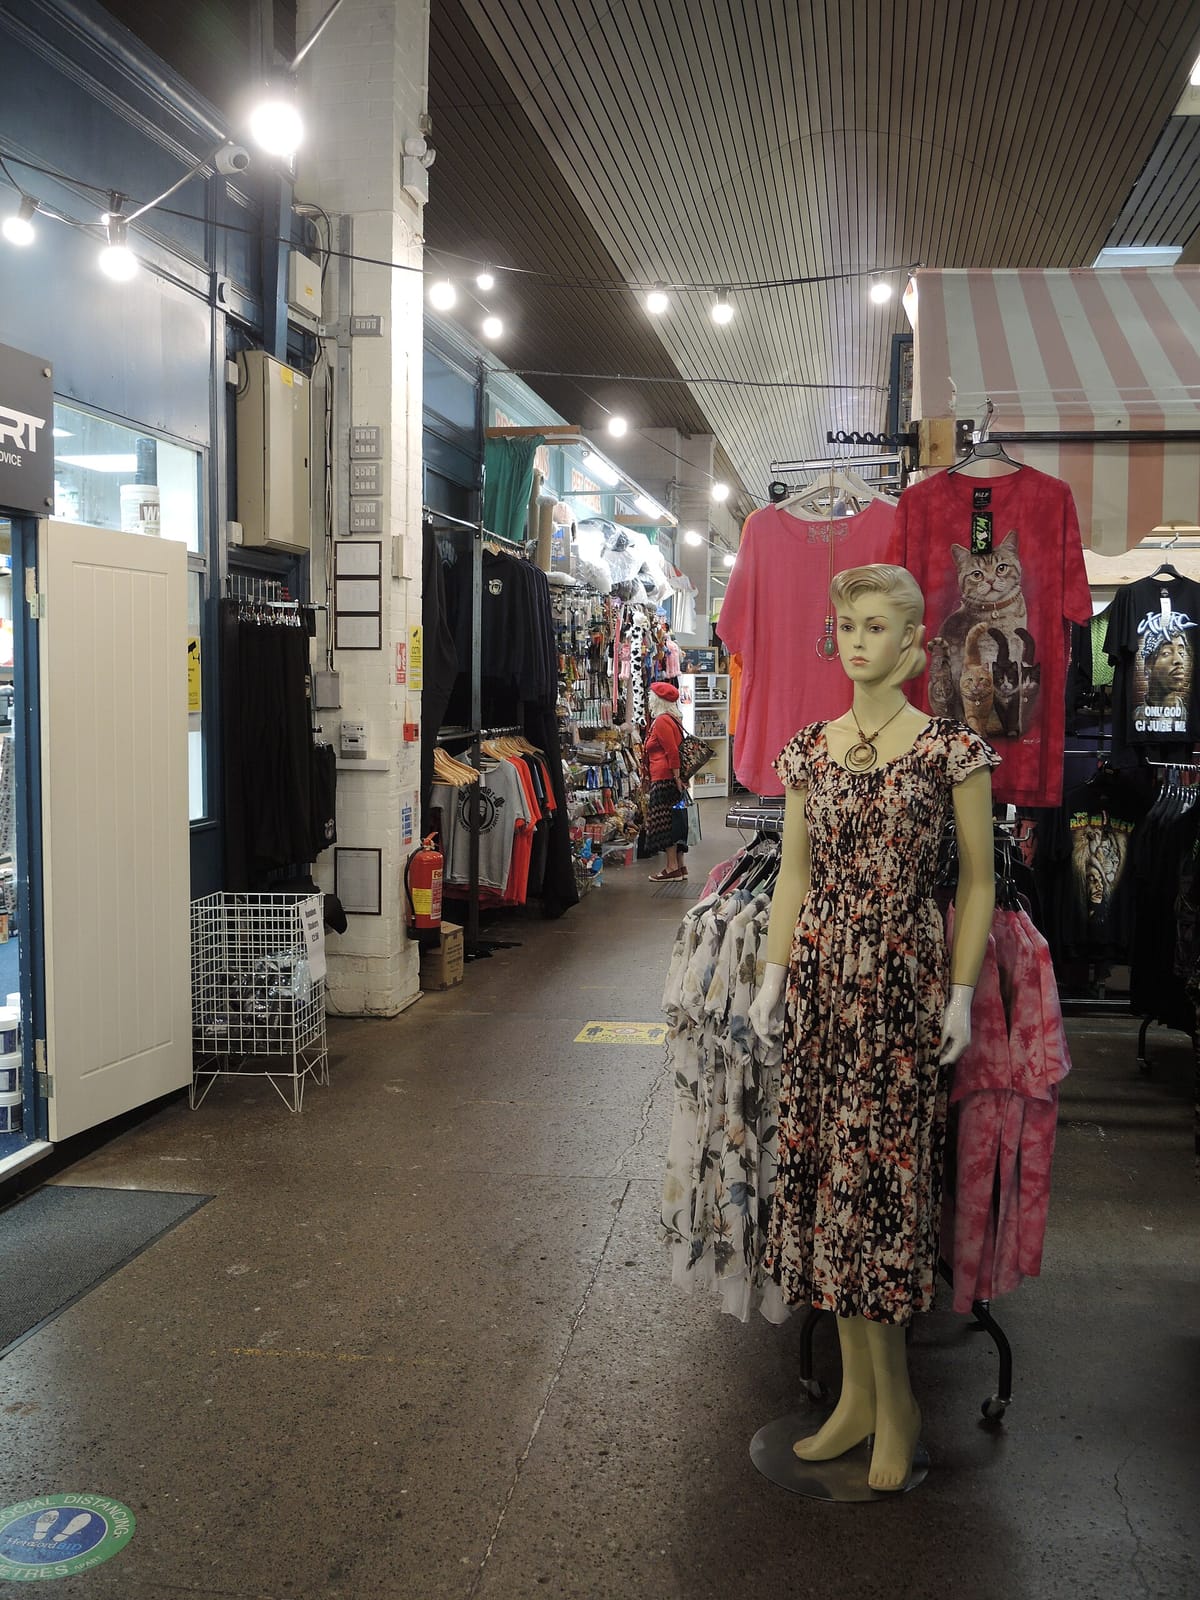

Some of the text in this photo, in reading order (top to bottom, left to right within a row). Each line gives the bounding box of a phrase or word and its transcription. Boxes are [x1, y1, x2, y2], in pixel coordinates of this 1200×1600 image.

[1164, 705, 1182, 718] GOD
[63, 1495, 131, 1539] DISTANCING
[0, 1564, 69, 1579] ETRES
